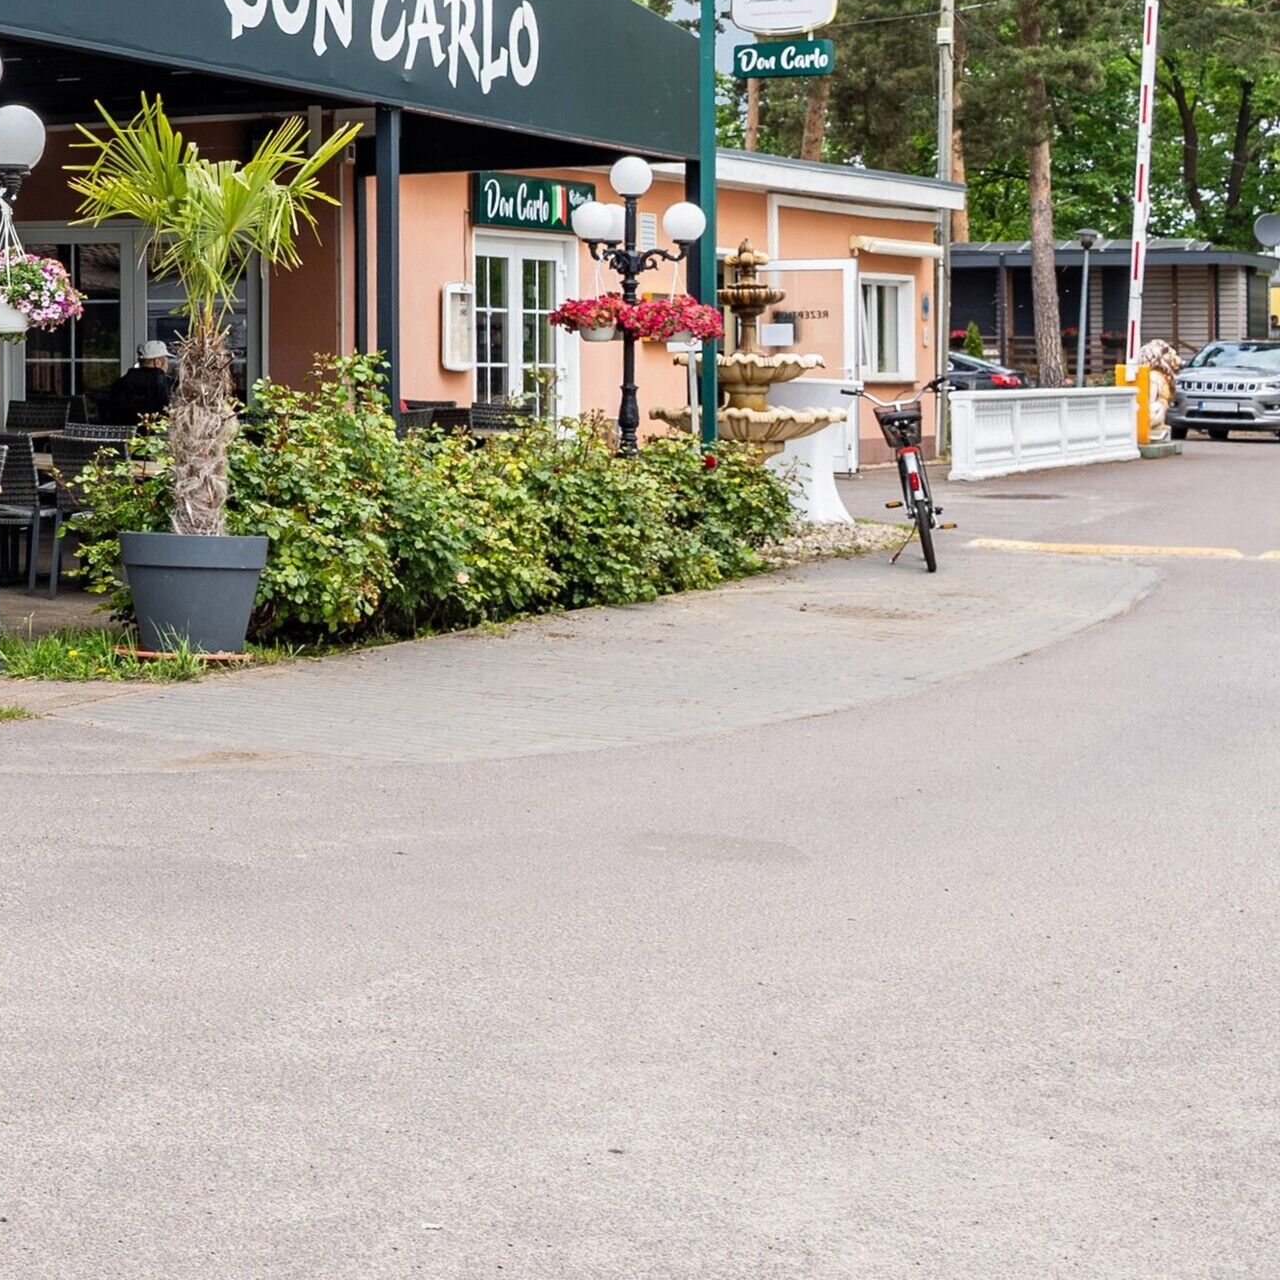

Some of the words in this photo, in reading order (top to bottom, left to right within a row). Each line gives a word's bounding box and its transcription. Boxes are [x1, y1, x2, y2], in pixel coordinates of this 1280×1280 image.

[737, 48, 776, 72] Don
[780, 46, 829, 70] Carlo
[484, 179, 514, 218] Don
[517, 183, 549, 223] Carlo
